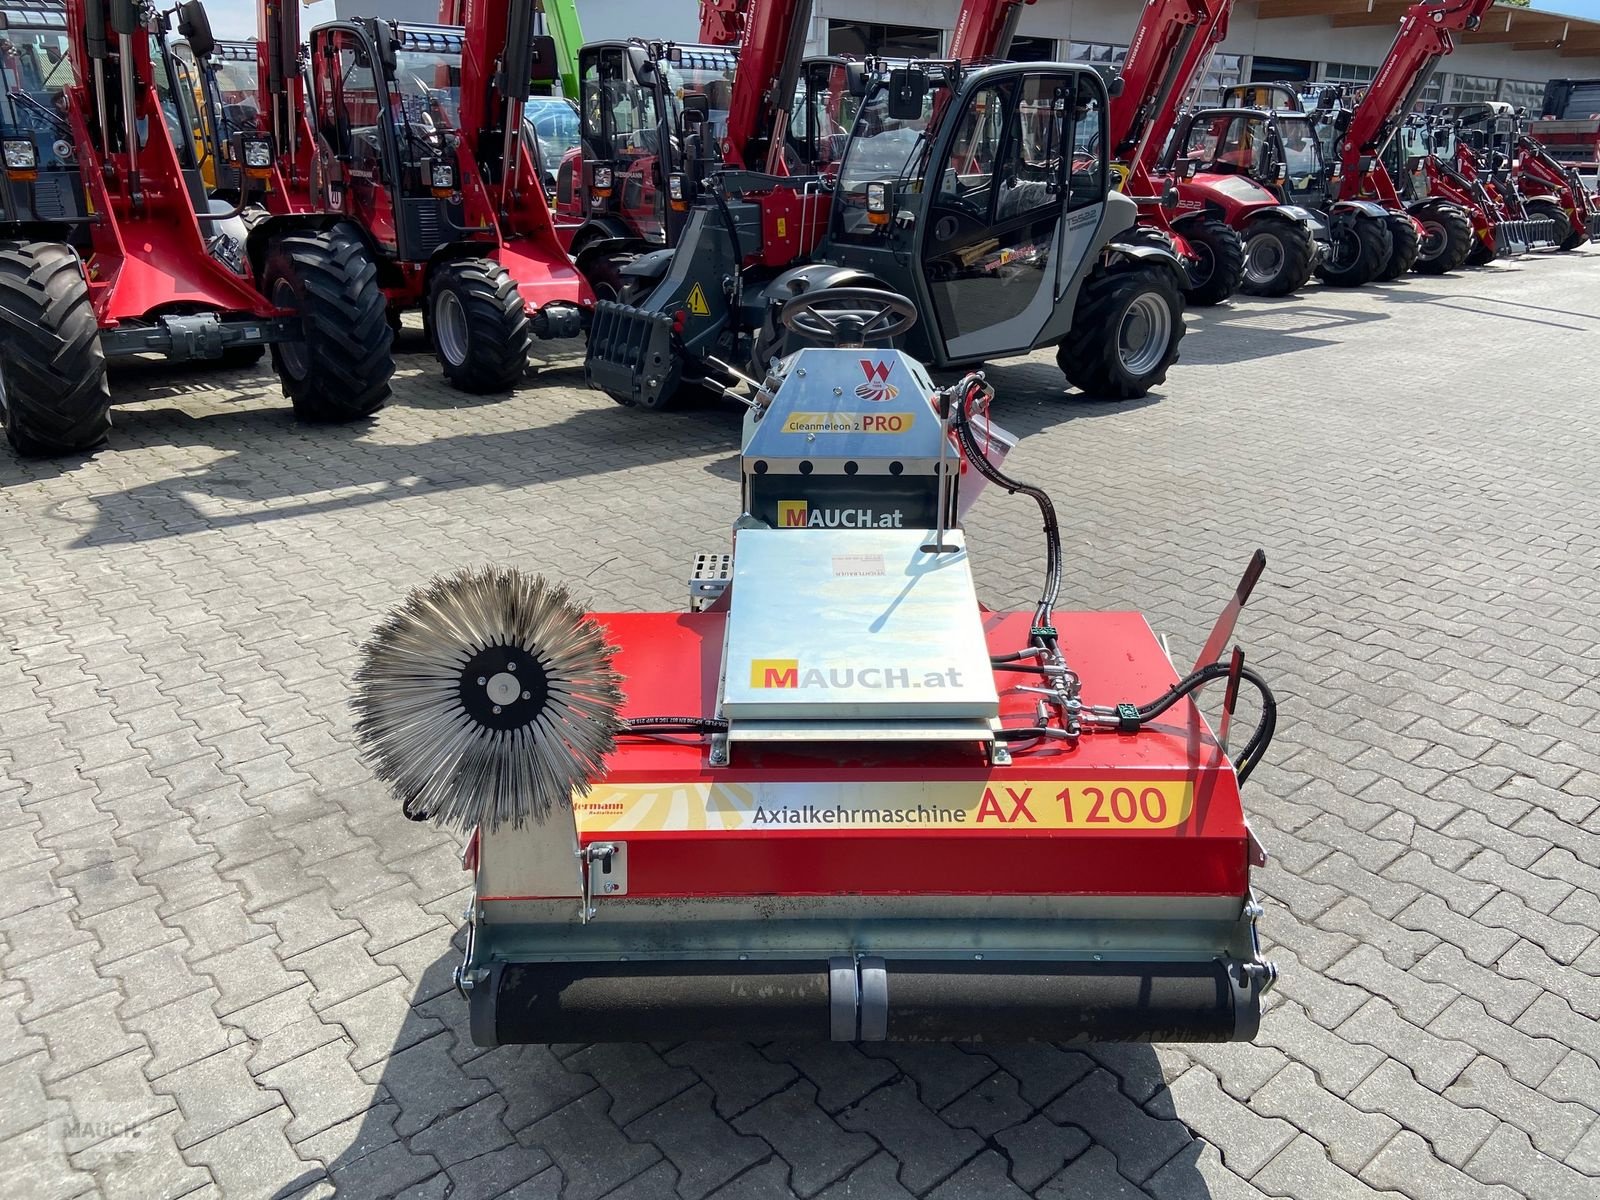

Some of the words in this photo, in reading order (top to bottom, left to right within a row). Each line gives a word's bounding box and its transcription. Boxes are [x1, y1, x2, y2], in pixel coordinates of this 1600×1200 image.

[951, 9, 968, 60] WEIDEMANN
[1126, 25, 1147, 70] WEIDEMANN
[1176, 199, 1202, 210] 522
[789, 422, 851, 431] Cleanmeleon
[854, 422, 860, 431] 2
[863, 415, 903, 431] PRO
[786, 508, 903, 528] MAUCH.at
[764, 667, 964, 689] MAUCH.at
[752, 804, 967, 824] Axialkehrmaschine
[975, 787, 1038, 823] AX
[1055, 787, 1167, 823] 1200
